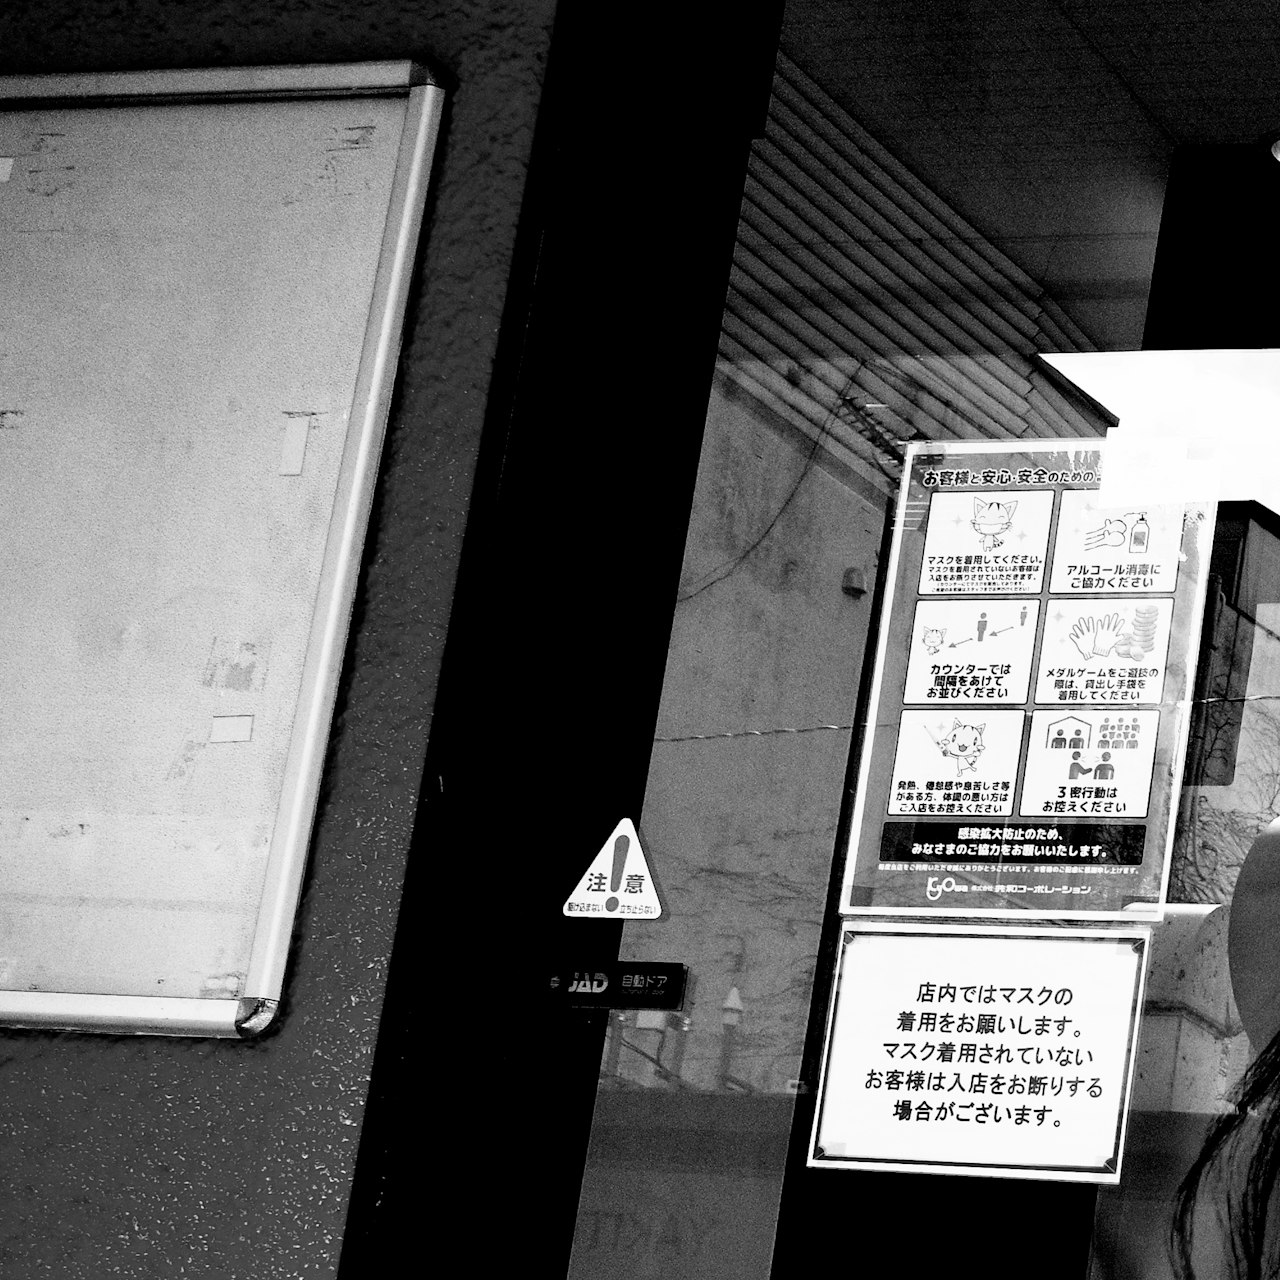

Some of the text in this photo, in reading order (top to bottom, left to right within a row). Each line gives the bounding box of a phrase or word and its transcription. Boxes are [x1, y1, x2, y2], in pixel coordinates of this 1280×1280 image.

[928, 555, 1043, 565] マスクを着用してください。
[1067, 563, 1161, 576] アルコール消毒に
[1071, 576, 1154, 588] ご協力ください
[930, 664, 1011, 676] カウンターでは
[1047, 667, 1159, 679] メダルゲームをご遊技の
[934, 675, 1003, 687] 間隔をあけて
[1054, 678, 1147, 690] 際は、貸出し手袋を
[926, 687, 1008, 698] お並びください
[1058, 690, 1140, 701] 着用してください
[899, 803, 1002, 814] ご入店をお控えください
[1043, 800, 1126, 813] お控えください
[958, 828, 1065, 841] 感染拡大防止のため、
[912, 842, 1108, 858] みなさまのご協力をお願いいたします。
[622, 975, 667, 987] 自動ドア
[917, 982, 1073, 1006] 店内ではマスクの
[896, 1011, 1082, 1037] 着用をお願いします。
[883, 1042, 1093, 1067] マスク着用されていない
[865, 1069, 1103, 1098] お客様は入店をお断りする
[893, 1100, 1061, 1128] 場合がございます。
